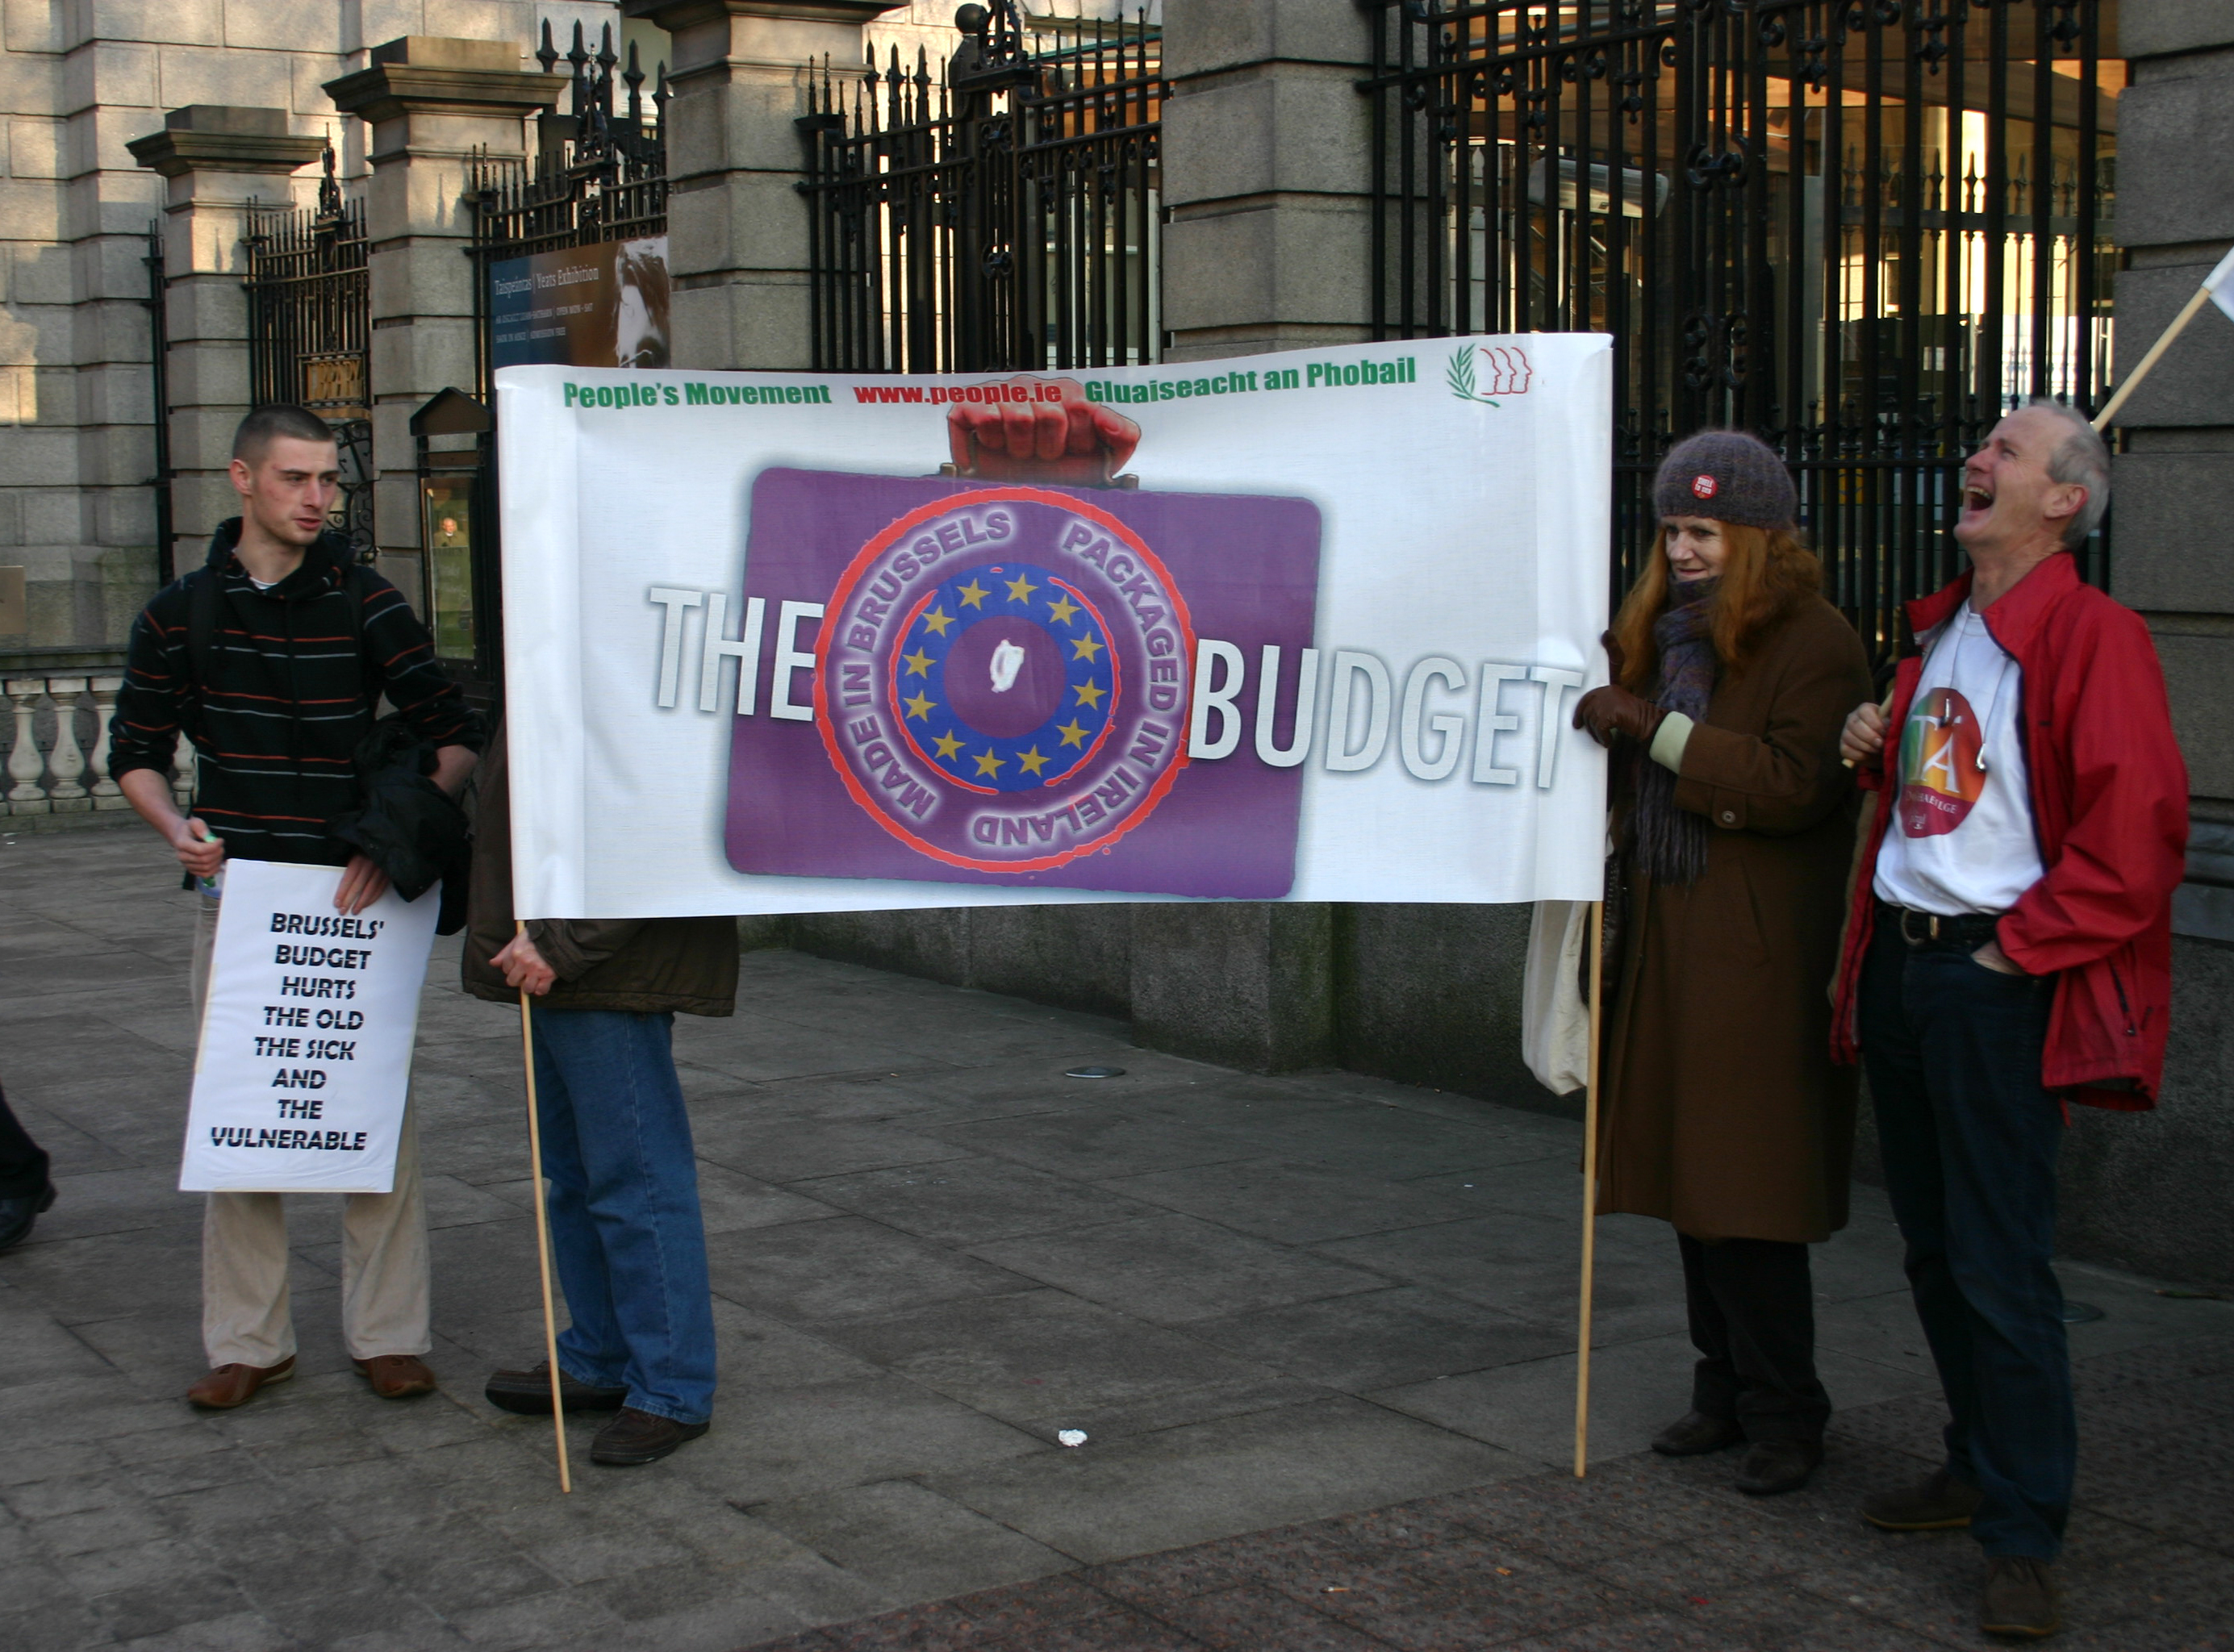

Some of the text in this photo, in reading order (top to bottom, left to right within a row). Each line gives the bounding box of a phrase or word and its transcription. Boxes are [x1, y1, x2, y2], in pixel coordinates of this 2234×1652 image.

[495, 265, 599, 298] Taispeántas Yeats Exhibition
[1085, 357, 1416, 403] Gluaiseacht an Phobail
[563, 382, 832, 409] People's Movement
[853, 383, 1062, 405] www.people.ie
[842, 511, 1012, 820] MADE IN BRUSSELS
[650, 587, 1583, 789] THE BUDGET
[973, 522, 1179, 845] PACKAGED IN IRELAND
[270, 912, 384, 940] BRUSSELS'
[274, 945, 372, 970] BUDGET
[281, 976, 357, 1000] HURTS
[264, 1006, 365, 1030] THE OLD
[254, 1037, 357, 1061] THE SICK
[271, 1068, 327, 1089] AND
[278, 1099, 324, 1120] THE
[211, 1126, 367, 1151] VULNERABLE
